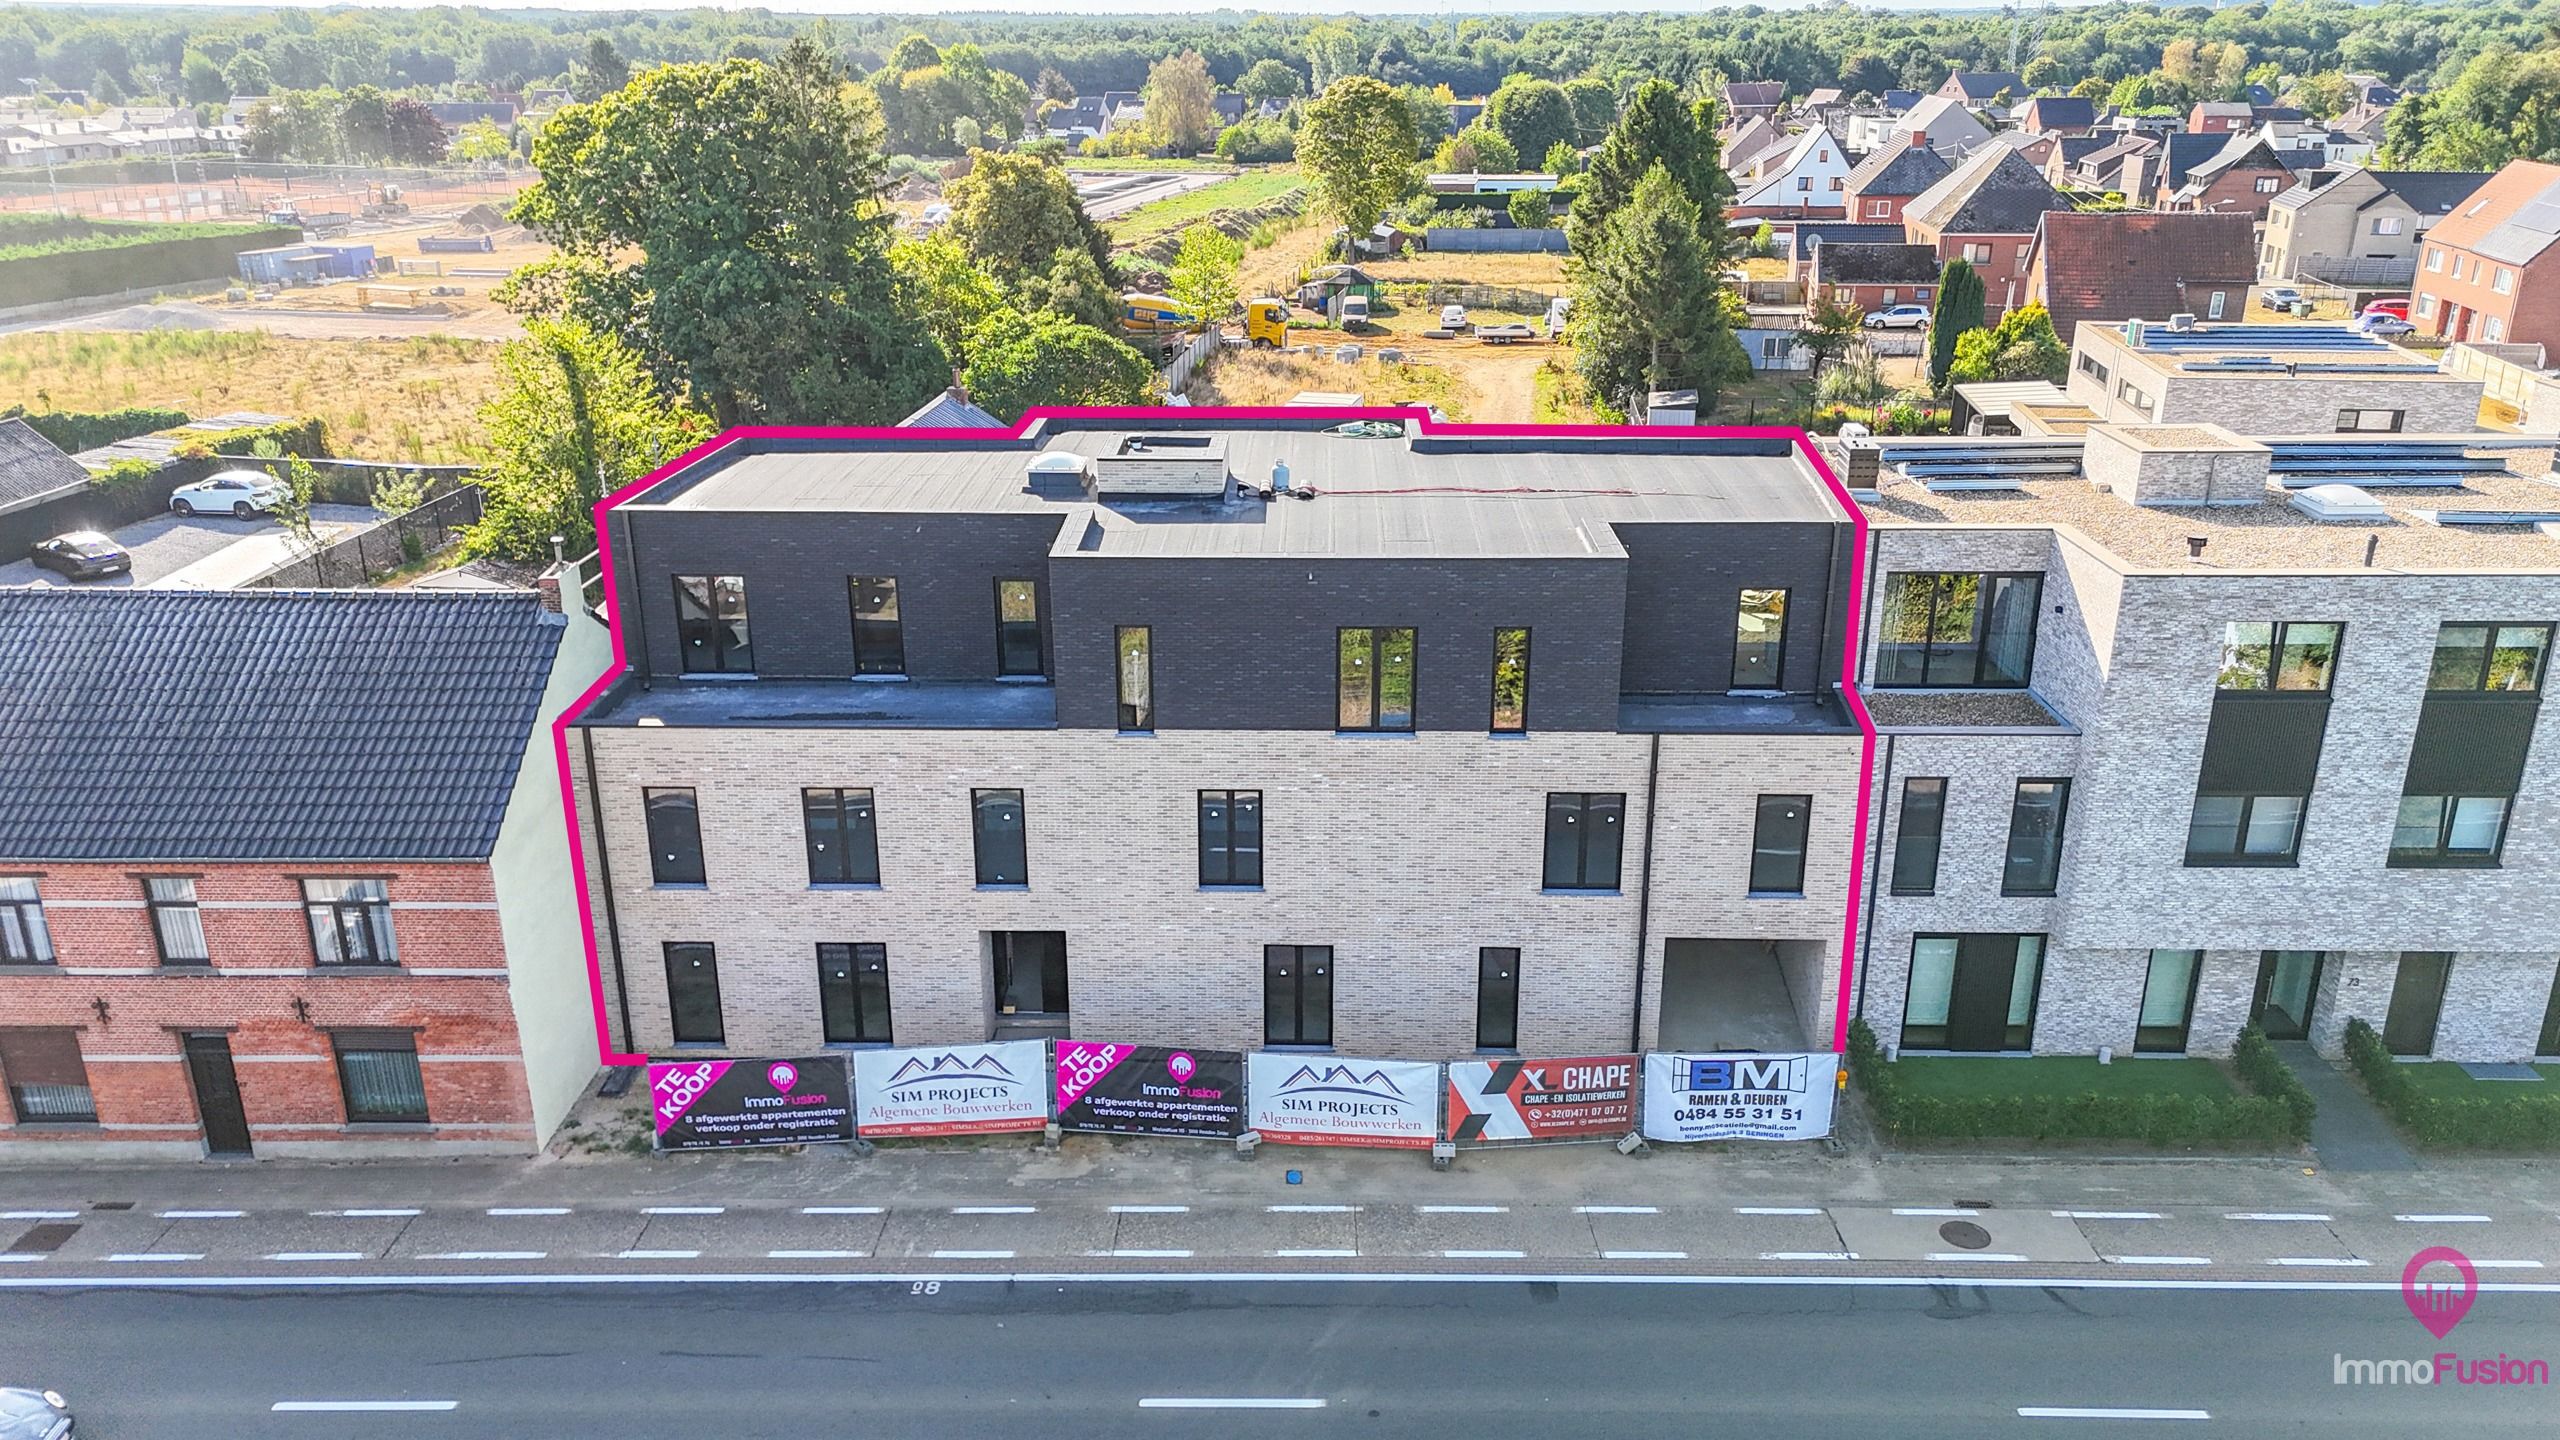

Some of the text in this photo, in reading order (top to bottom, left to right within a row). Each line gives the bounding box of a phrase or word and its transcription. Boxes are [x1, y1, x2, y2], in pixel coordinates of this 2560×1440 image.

[2347, 977, 2360, 987] 73
[1060, 1045, 1092, 1072] TE
[1061, 1044, 1116, 1098] KOOP
[1522, 1064, 1631, 1091] XL CHAPE
[1691, 1060, 1790, 1090] BM
[654, 1068, 688, 1094] TE
[658, 1063, 712, 1119] KOOP
[891, 1085, 1008, 1103] SIM PROJECTS
[1142, 1083, 1222, 1099] ImmoFusion
[1524, 1090, 1626, 1104] CHAPE -EN ISOLATIEWERKEN
[1688, 1092, 1788, 1106] RAMEN & DEUREN
[744, 1093, 827, 1108] ImmoFusion
[1084, 1096, 1238, 1114] 8 afgewerkte appartementen
[1281, 1098, 1399, 1117] SIM PROJECTS
[684, 1108, 846, 1125] 8 afgewerkte appartementen
[868, 1100, 1033, 1121] Algemene Bouwwerken
[1093, 1107, 1230, 1123] verkoop onder registratie.
[1544, 1105, 1628, 1118] +32(0)471 07 07 77
[1674, 1108, 1802, 1121] 0484 55 31 51
[694, 1118, 839, 1134] verkoop onder registratie.
[1259, 1111, 1422, 1130] Algemene Bouwwerken
